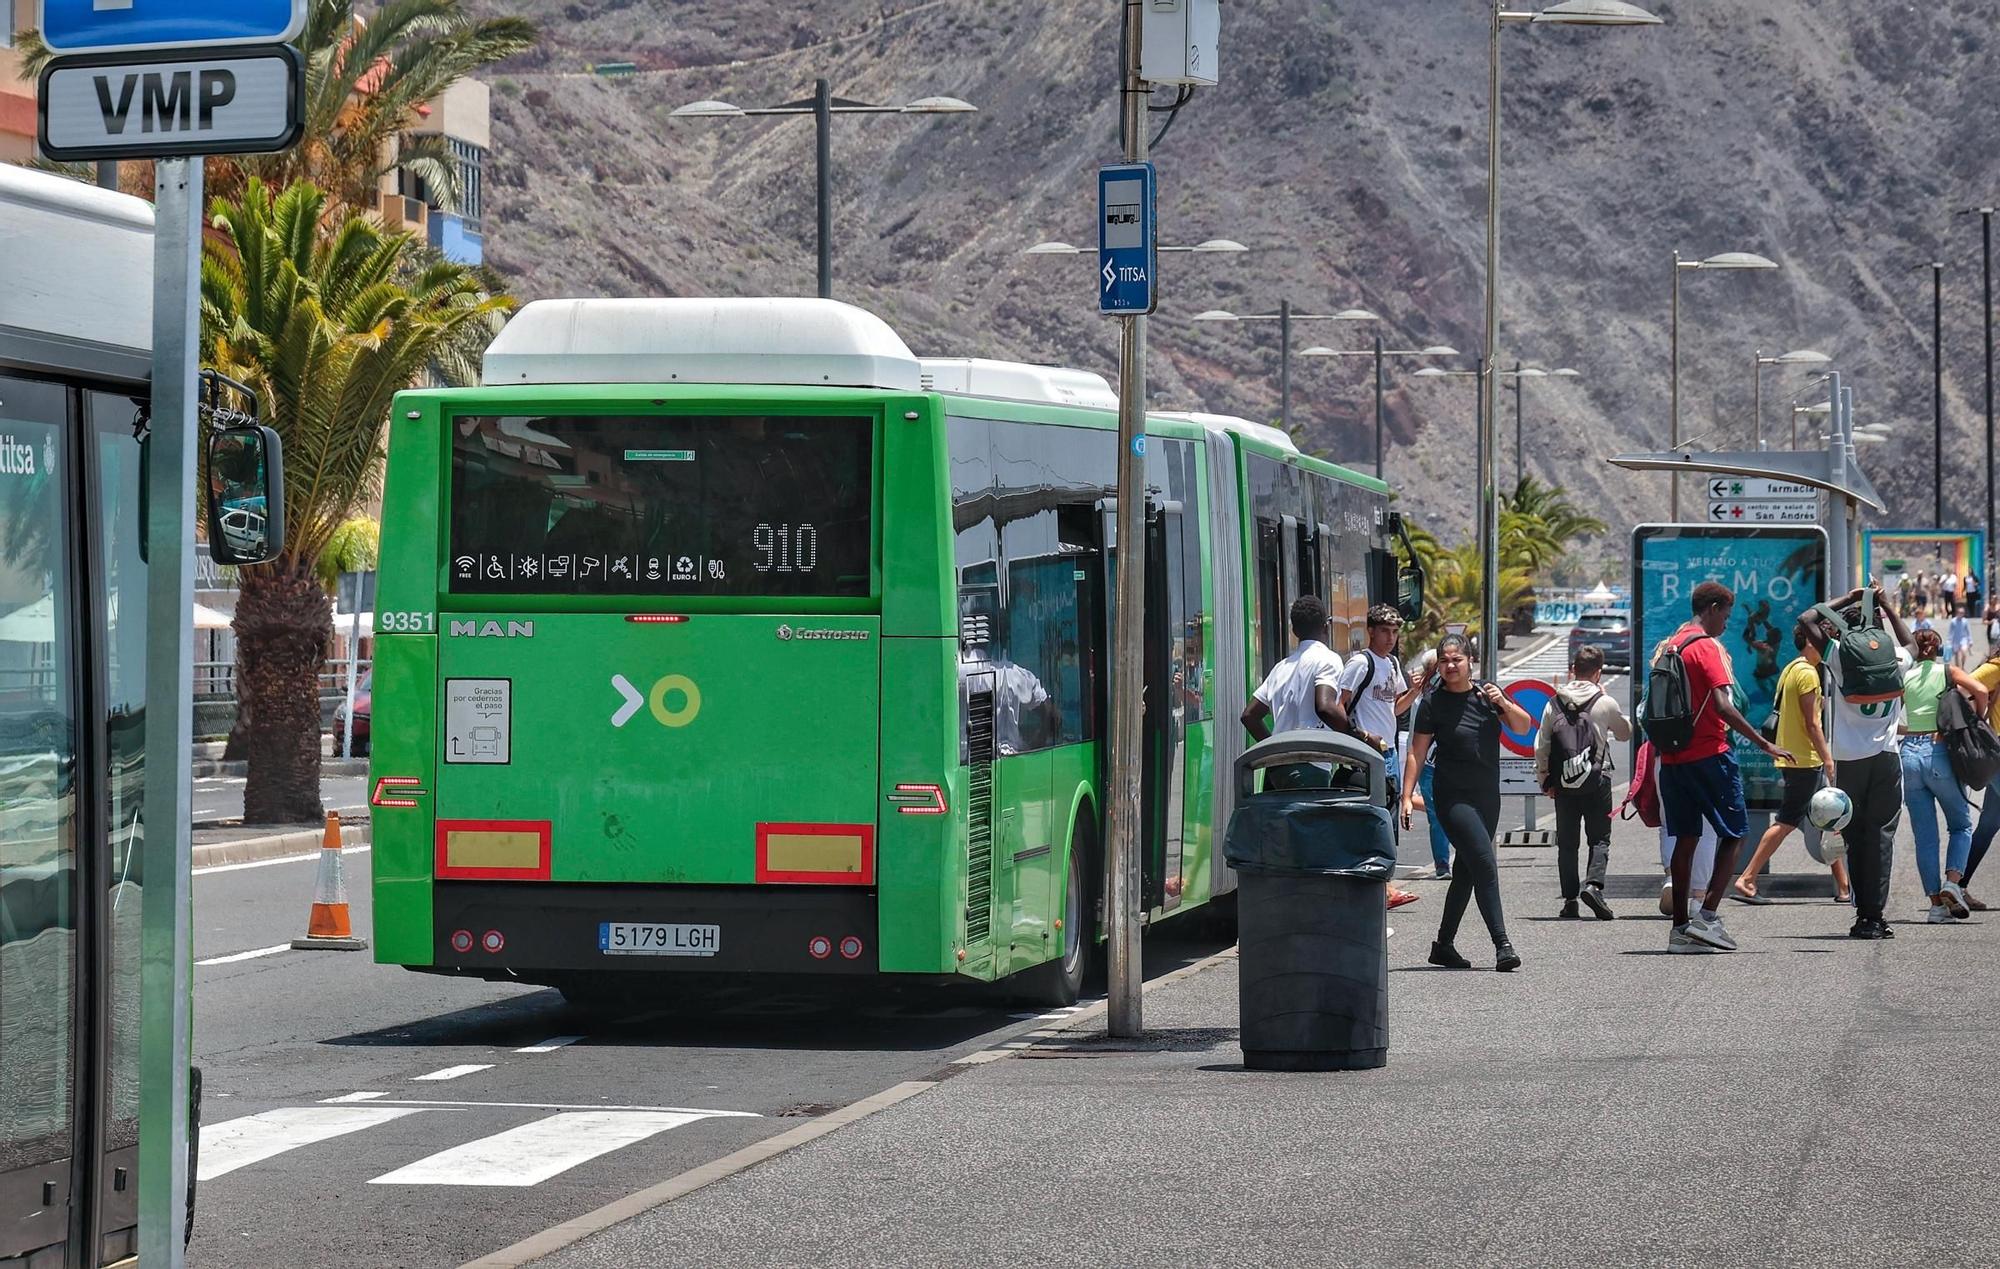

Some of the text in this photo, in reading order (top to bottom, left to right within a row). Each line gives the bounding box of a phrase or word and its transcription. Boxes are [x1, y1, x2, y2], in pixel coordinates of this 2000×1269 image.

[93, 69, 236, 134] VMP
[1768, 483, 1815, 493] farmacia
[1755, 511, 1775, 520] San
[753, 523, 817, 572] 910
[1741, 558, 1748, 566] A
[382, 611, 433, 631] 9351
[450, 620, 534, 638] MAN
[795, 627, 870, 640] Castrosua
[474, 687, 503, 695] Gracias
[614, 926, 715, 948] 5179 LGH
